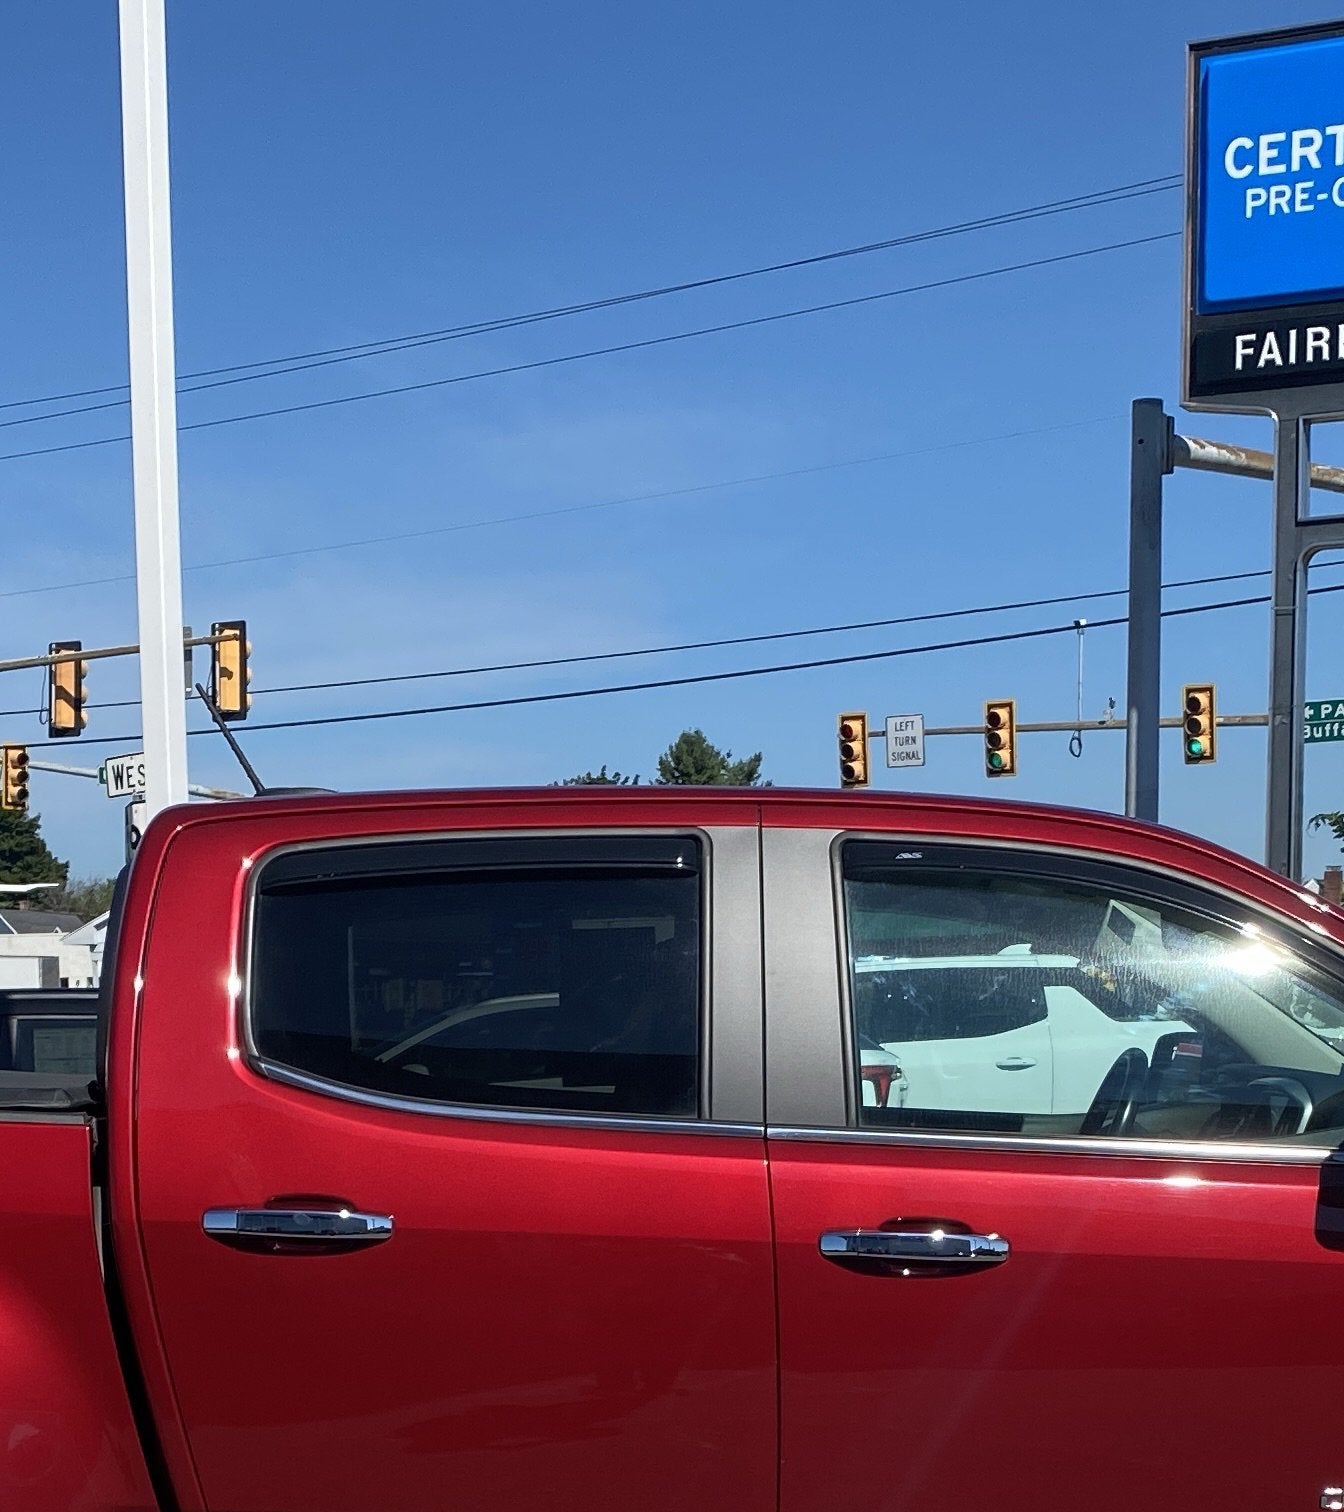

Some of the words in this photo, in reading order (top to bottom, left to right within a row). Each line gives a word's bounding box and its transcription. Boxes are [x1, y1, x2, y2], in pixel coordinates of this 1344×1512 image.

[894, 720, 915, 732] LEFT
[894, 735, 917, 747] TURN
[891, 750, 922, 762] SIGNAL
[112, 763, 146, 790] WES
